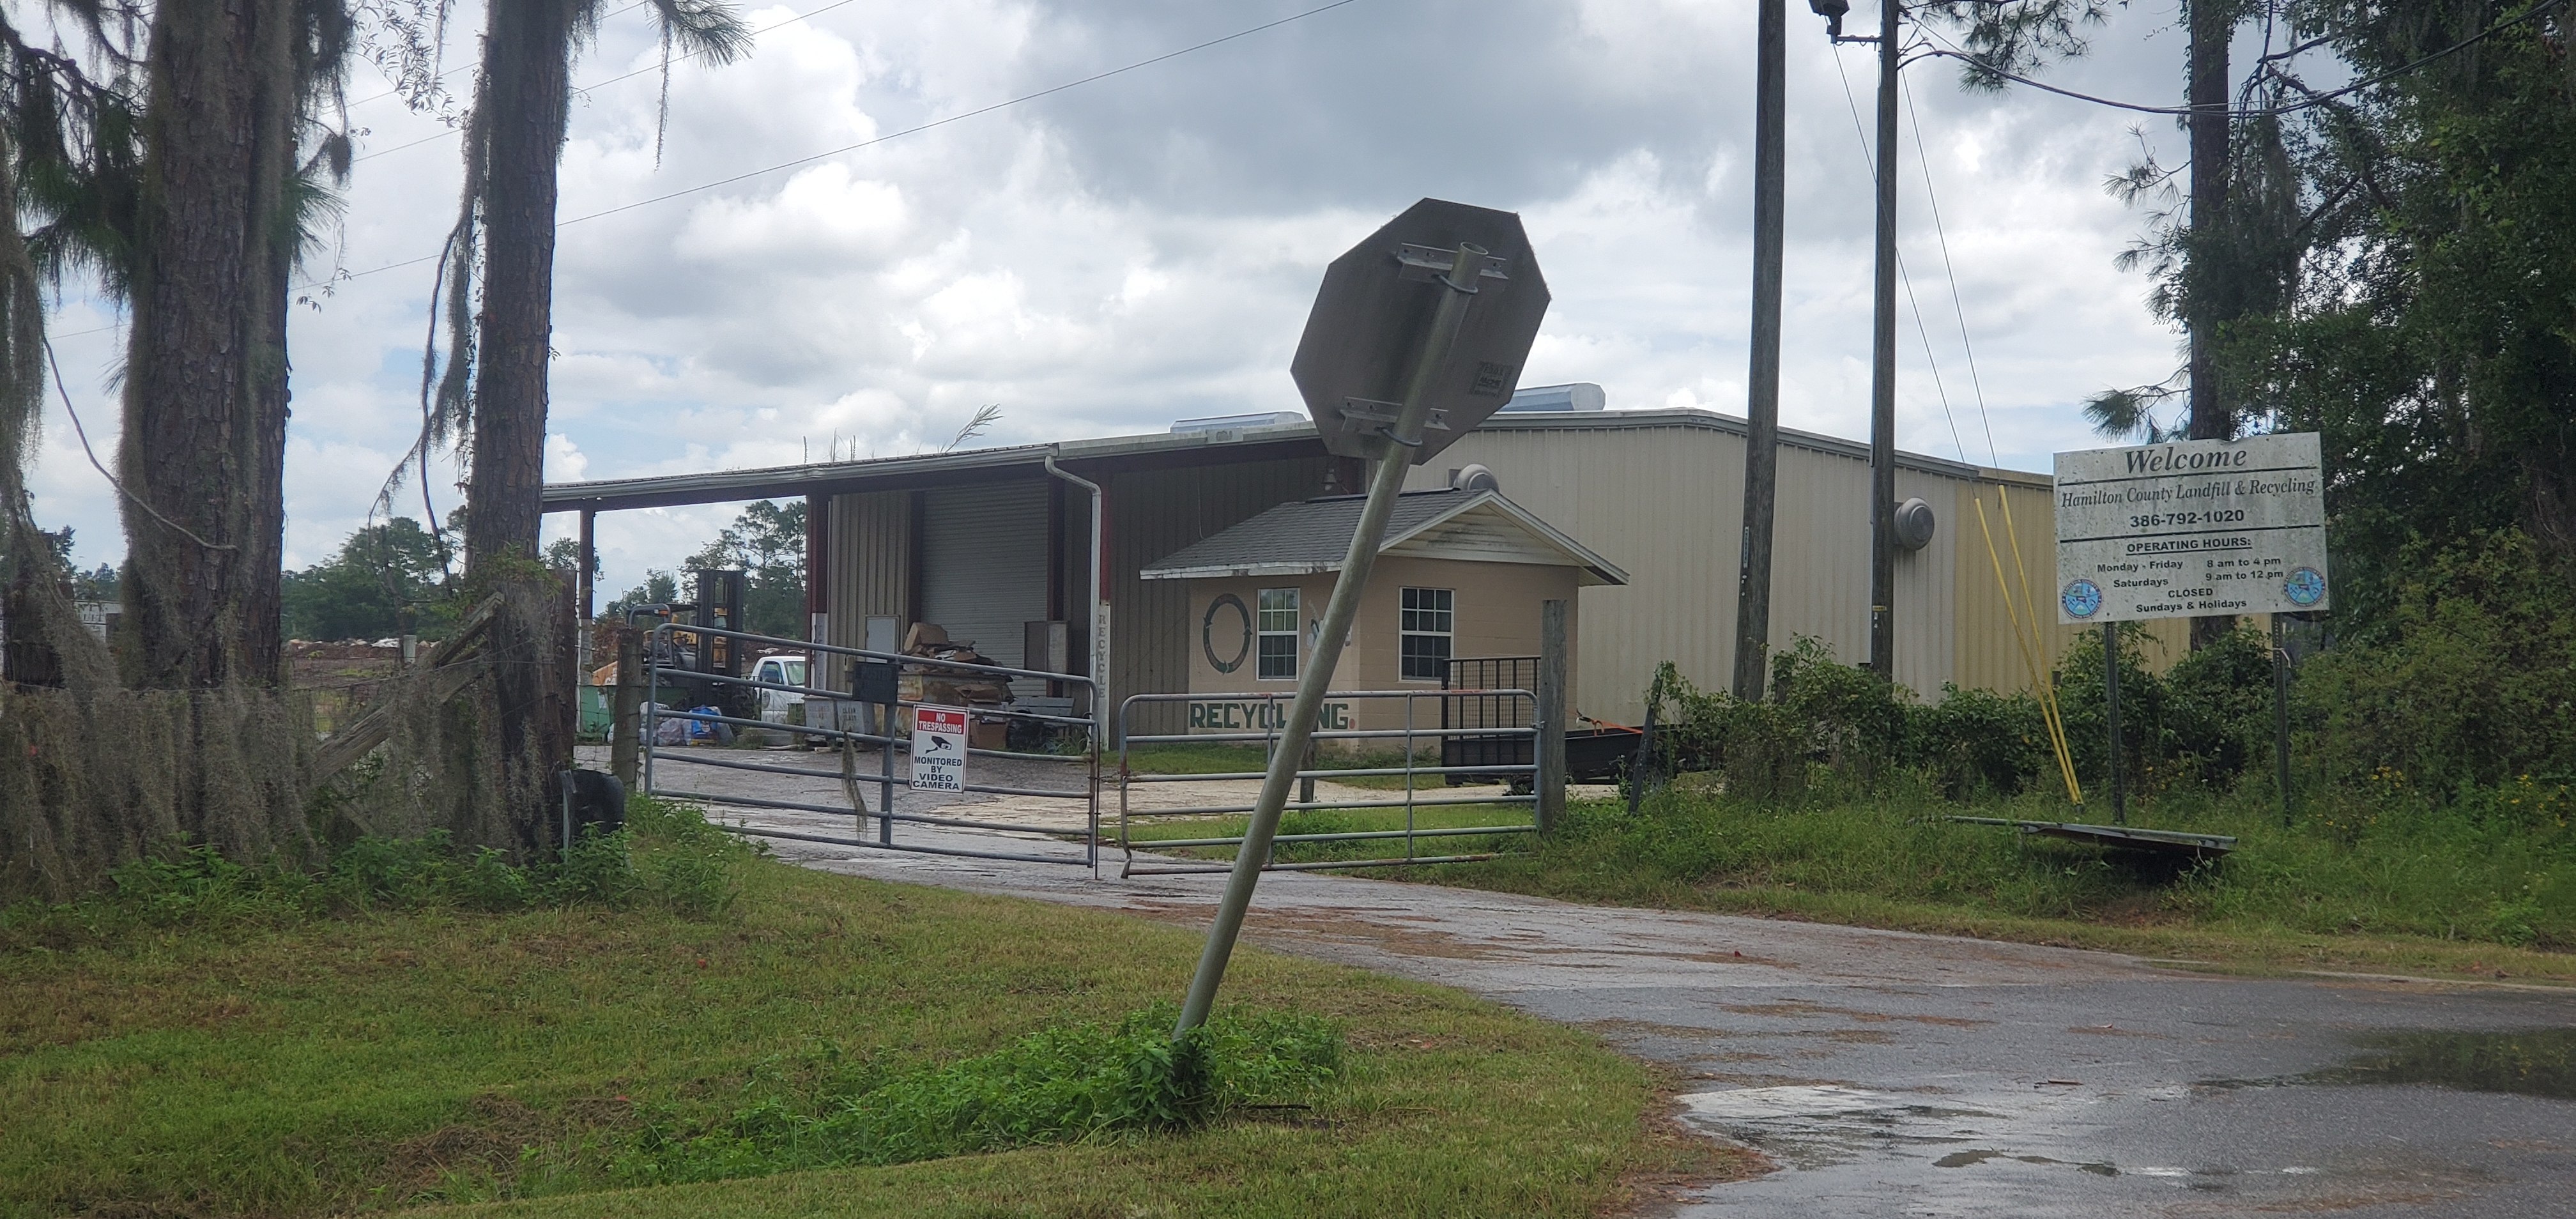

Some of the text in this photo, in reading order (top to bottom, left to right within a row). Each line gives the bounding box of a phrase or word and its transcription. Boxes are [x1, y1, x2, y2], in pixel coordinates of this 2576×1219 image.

[2126, 447, 2247, 474] Welcome
[2061, 477, 2315, 507] Hamilton County Landfill & Recycling
[2129, 509, 2244, 528] 386-792-1020
[2126, 537, 2251, 553] OPERATING HOURS:
[2097, 562, 2138, 573] Monday
[2149, 560, 2184, 570] Friday
[2207, 560, 2214, 568] 8
[2264, 558, 2281, 567] pm
[2250, 570, 2264, 579] 12
[2267, 571, 2283, 580] pm
[2113, 578, 2169, 588] Saturdays
[2168, 588, 2213, 598] CLOSED
[2136, 599, 2247, 613] Sundays & Holidays
[1097, 615, 1107, 698] RECYCLE
[935, 712, 946, 723] NO
[918, 721, 962, 733] TRESPASSING
[914, 756, 962, 767] MONITORED
[931, 765, 942, 774] BY
[919, 772, 953, 782] VIDEO
[912, 780, 960, 790] CAMERA
